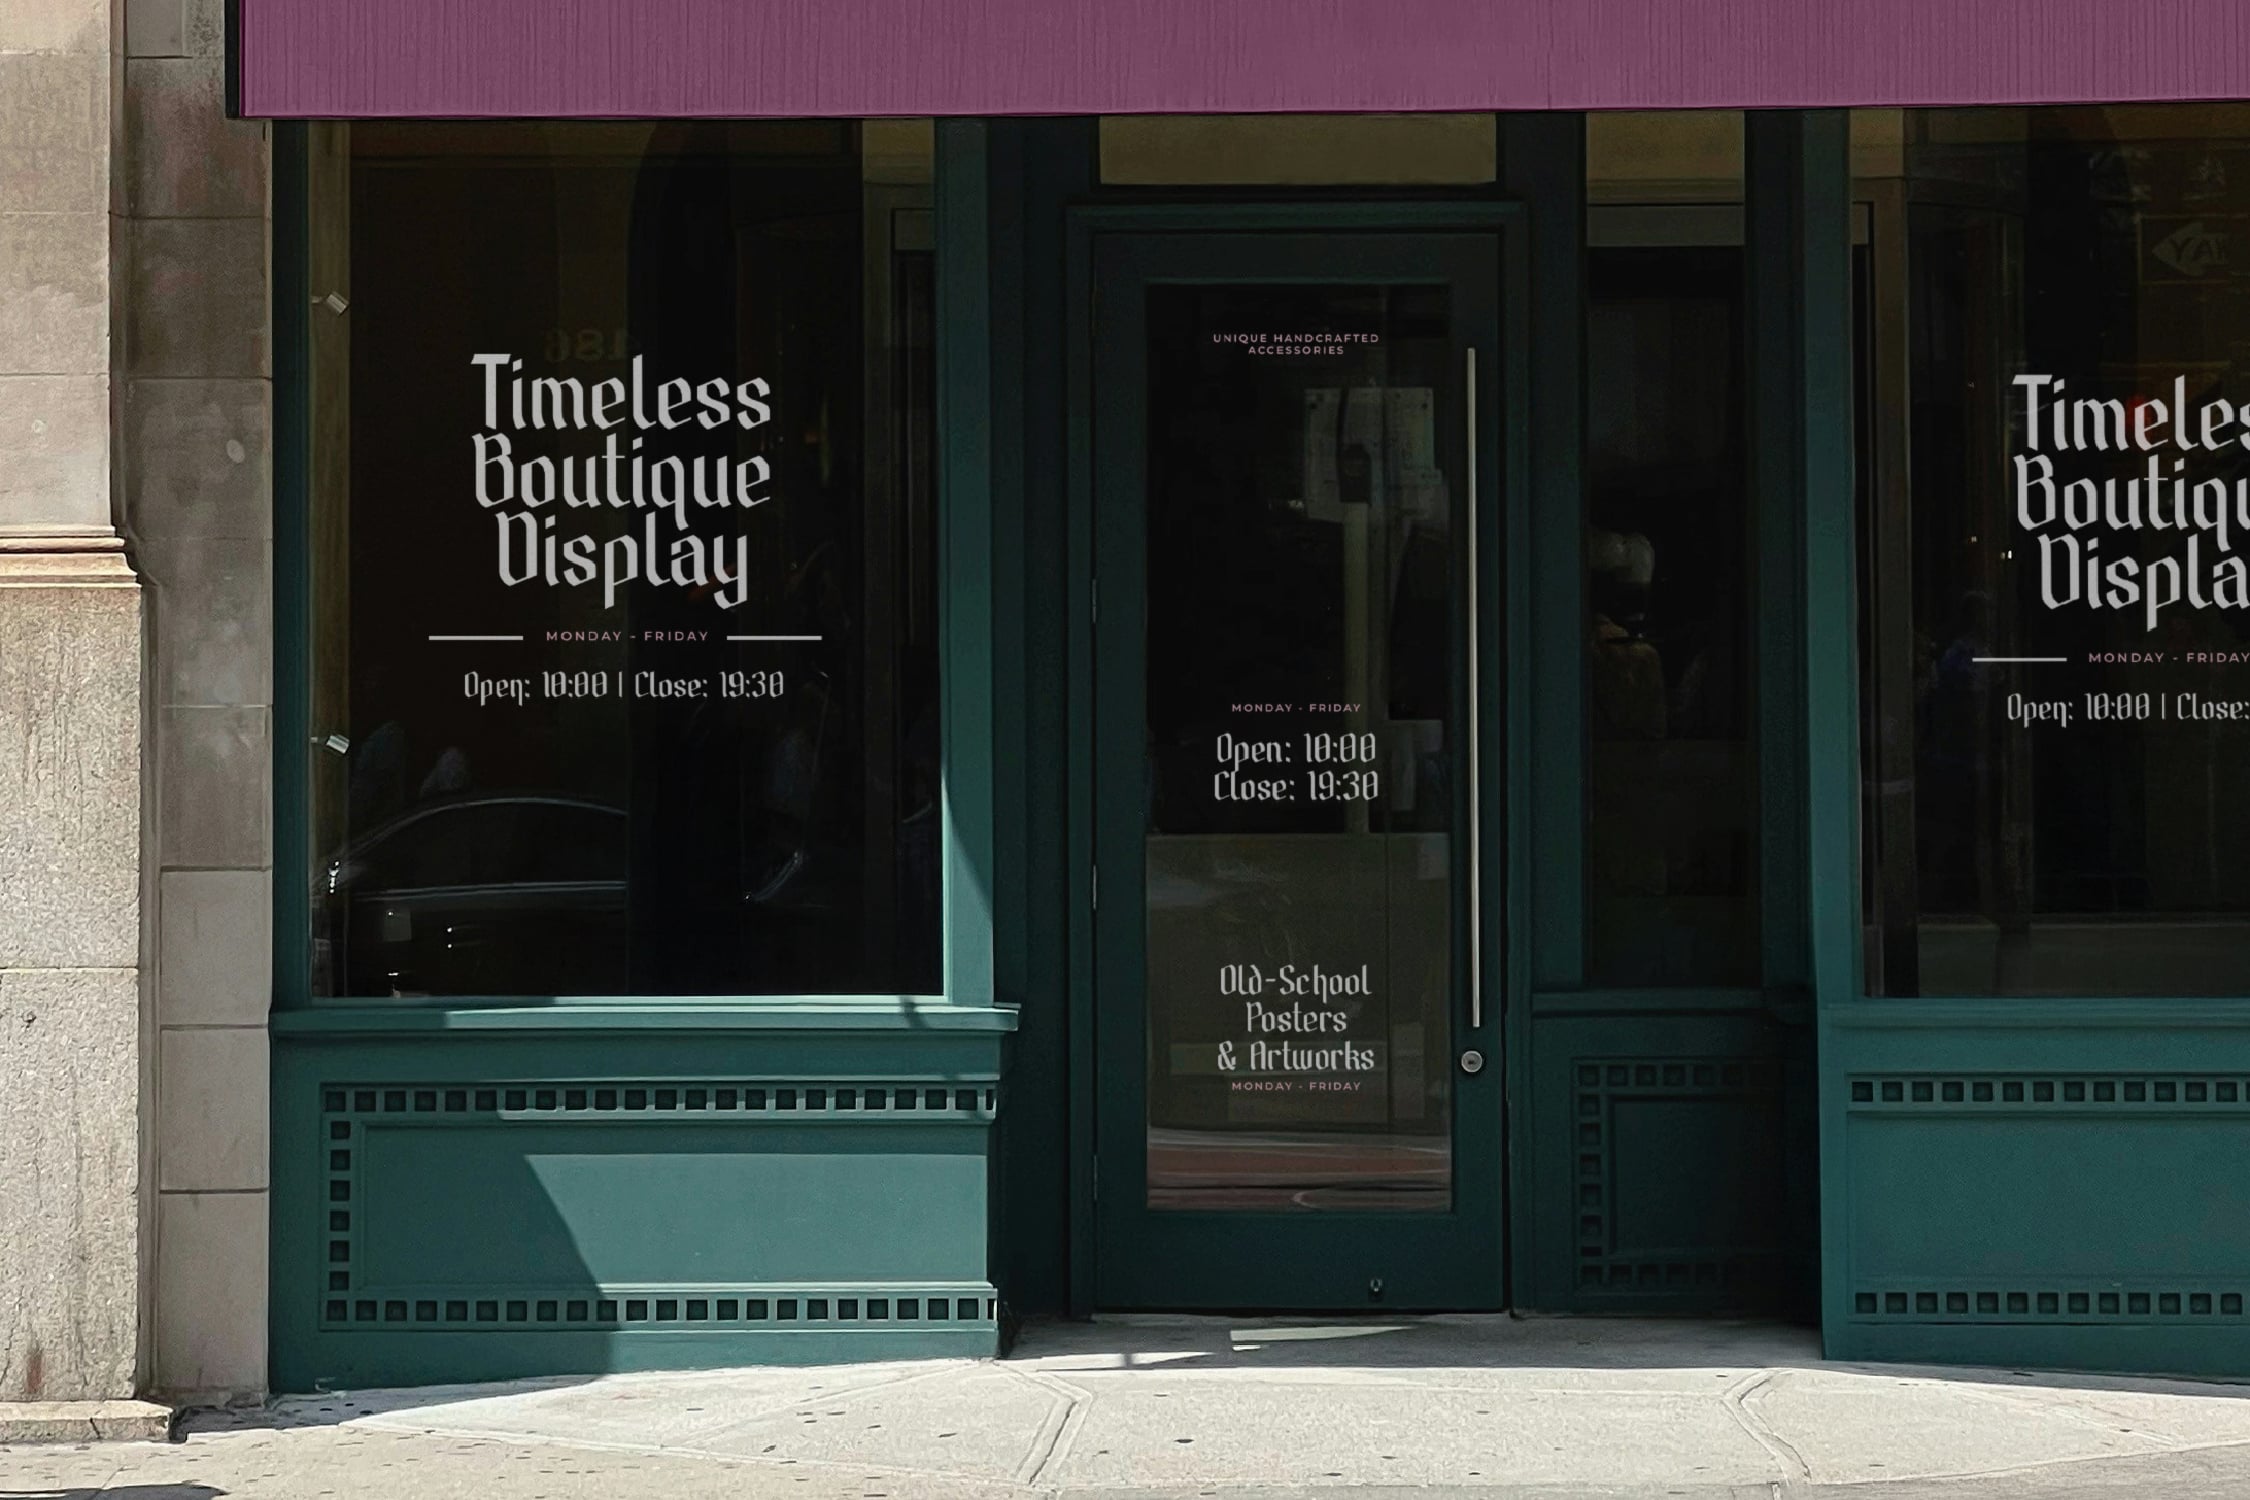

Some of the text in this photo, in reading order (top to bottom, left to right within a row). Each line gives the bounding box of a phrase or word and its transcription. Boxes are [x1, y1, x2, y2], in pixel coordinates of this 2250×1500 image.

[1213, 333, 1379, 344] UNIQUE HANDCRAFTED
[1248, 345, 1344, 355] ACCESSORIES
[471, 353, 771, 430] Timeless
[472, 432, 771, 531] Boutique
[495, 511, 748, 610] Display
[2037, 532, 2250, 632] Displa
[546, 631, 622, 641] MONDAY
[644, 631, 709, 641] FRIDAY
[2088, 652, 2164, 663] MONDAY
[2186, 652, 2250, 663] FRIDAY
[464, 671, 530, 707] Open:
[542, 671, 608, 698] 10:00
[635, 671, 708, 698] Close:
[720, 670, 784, 698] 19:30
[1232, 703, 1292, 713] MONDAY
[1309, 703, 1361, 713] FRIDAY
[2007, 692, 2073, 728] Open:
[2085, 692, 2150, 720] 10:00
[2177, 692, 2250, 720] Close:
[1216, 732, 1376, 769] Open: 10:00
[1214, 770, 1379, 801] Close: 19:30
[1220, 964, 1372, 1005] Old-School
[1246, 1001, 1347, 1033] Posters
[1217, 1040, 1375, 1071] & Artworks
[1232, 1081, 1292, 1091] MONDAY
[1309, 1081, 1361, 1091] FRIDAY
